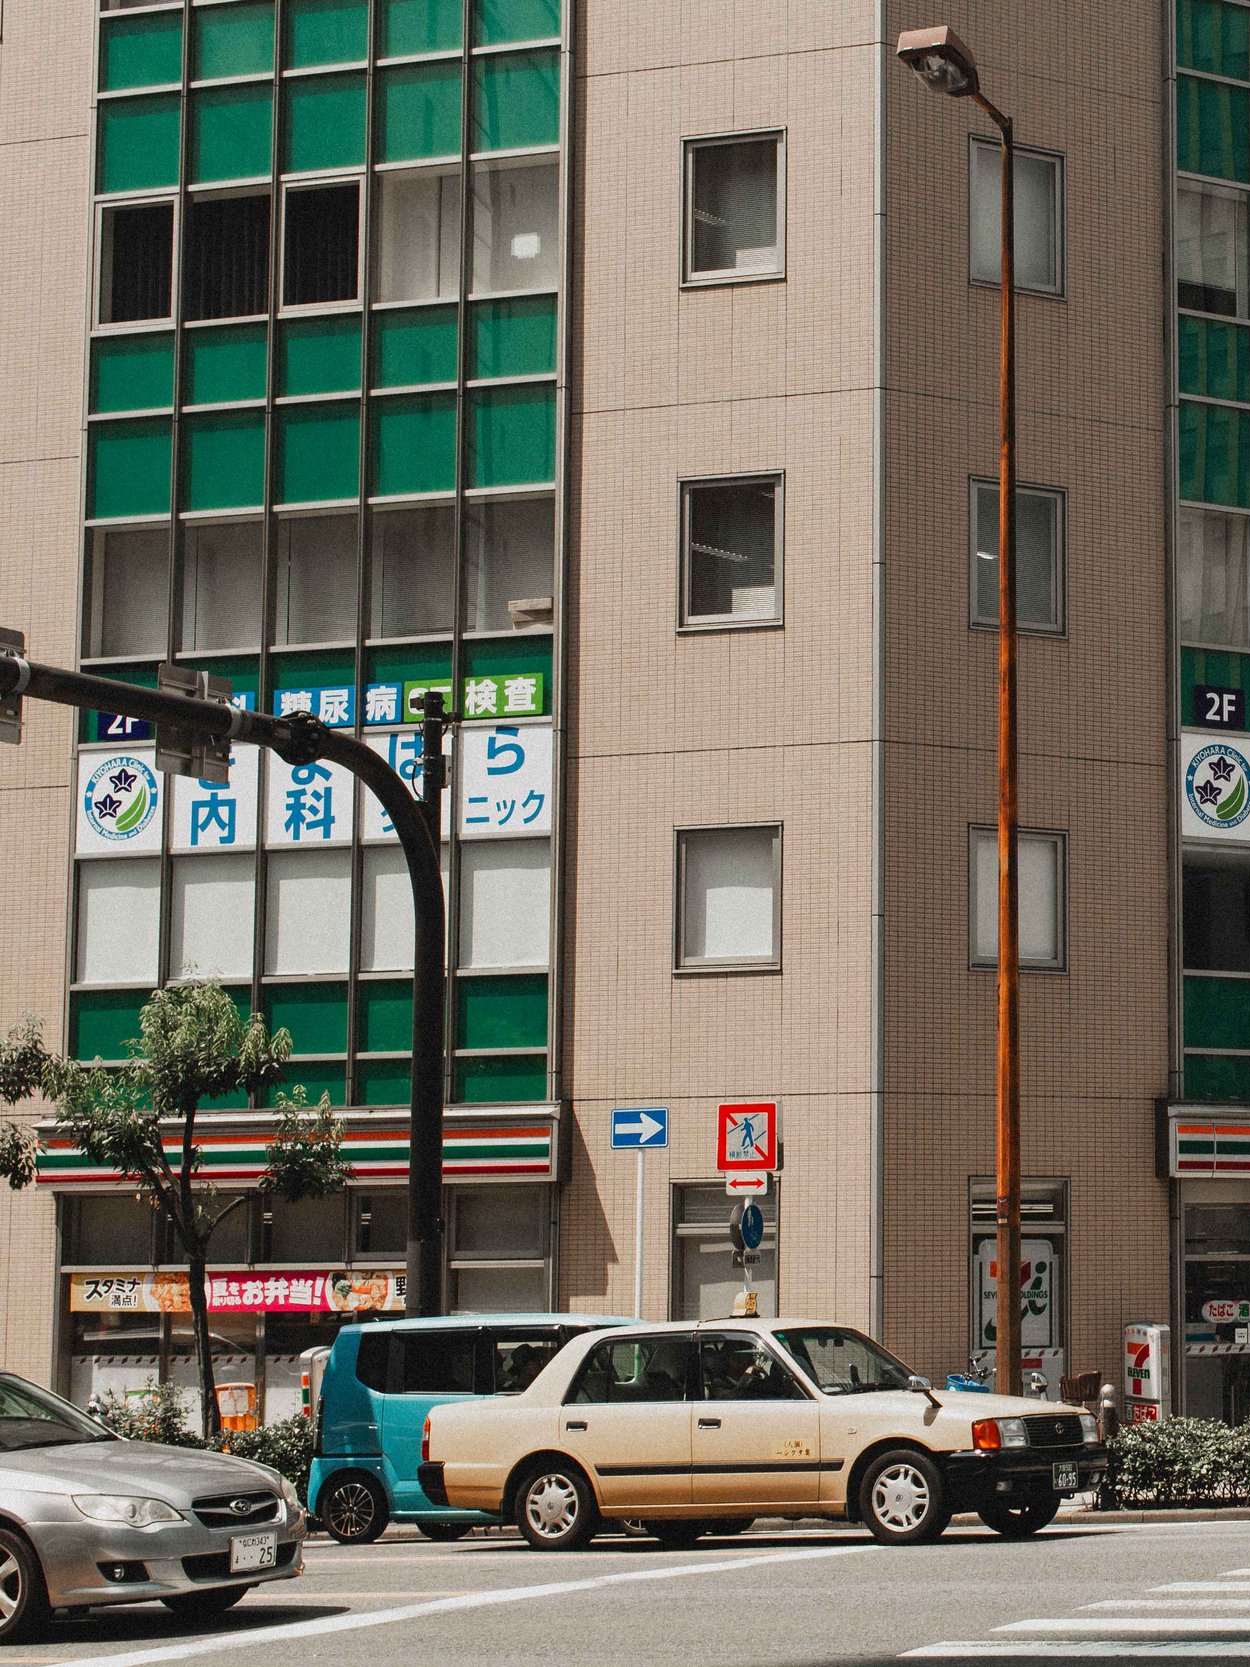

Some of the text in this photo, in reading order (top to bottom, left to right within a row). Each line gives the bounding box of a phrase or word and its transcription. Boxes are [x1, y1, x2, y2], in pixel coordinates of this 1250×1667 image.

[1205, 692, 1236, 722] 2F
[1192, 746, 1226, 767] KIYOHARA
[84, 1277, 141, 1300] スタミナ
[242, 1276, 325, 1306] お弁当!
[1020, 1291, 1048, 1300] OLDINGS
[1208, 1303, 1234, 1317] たばこ
